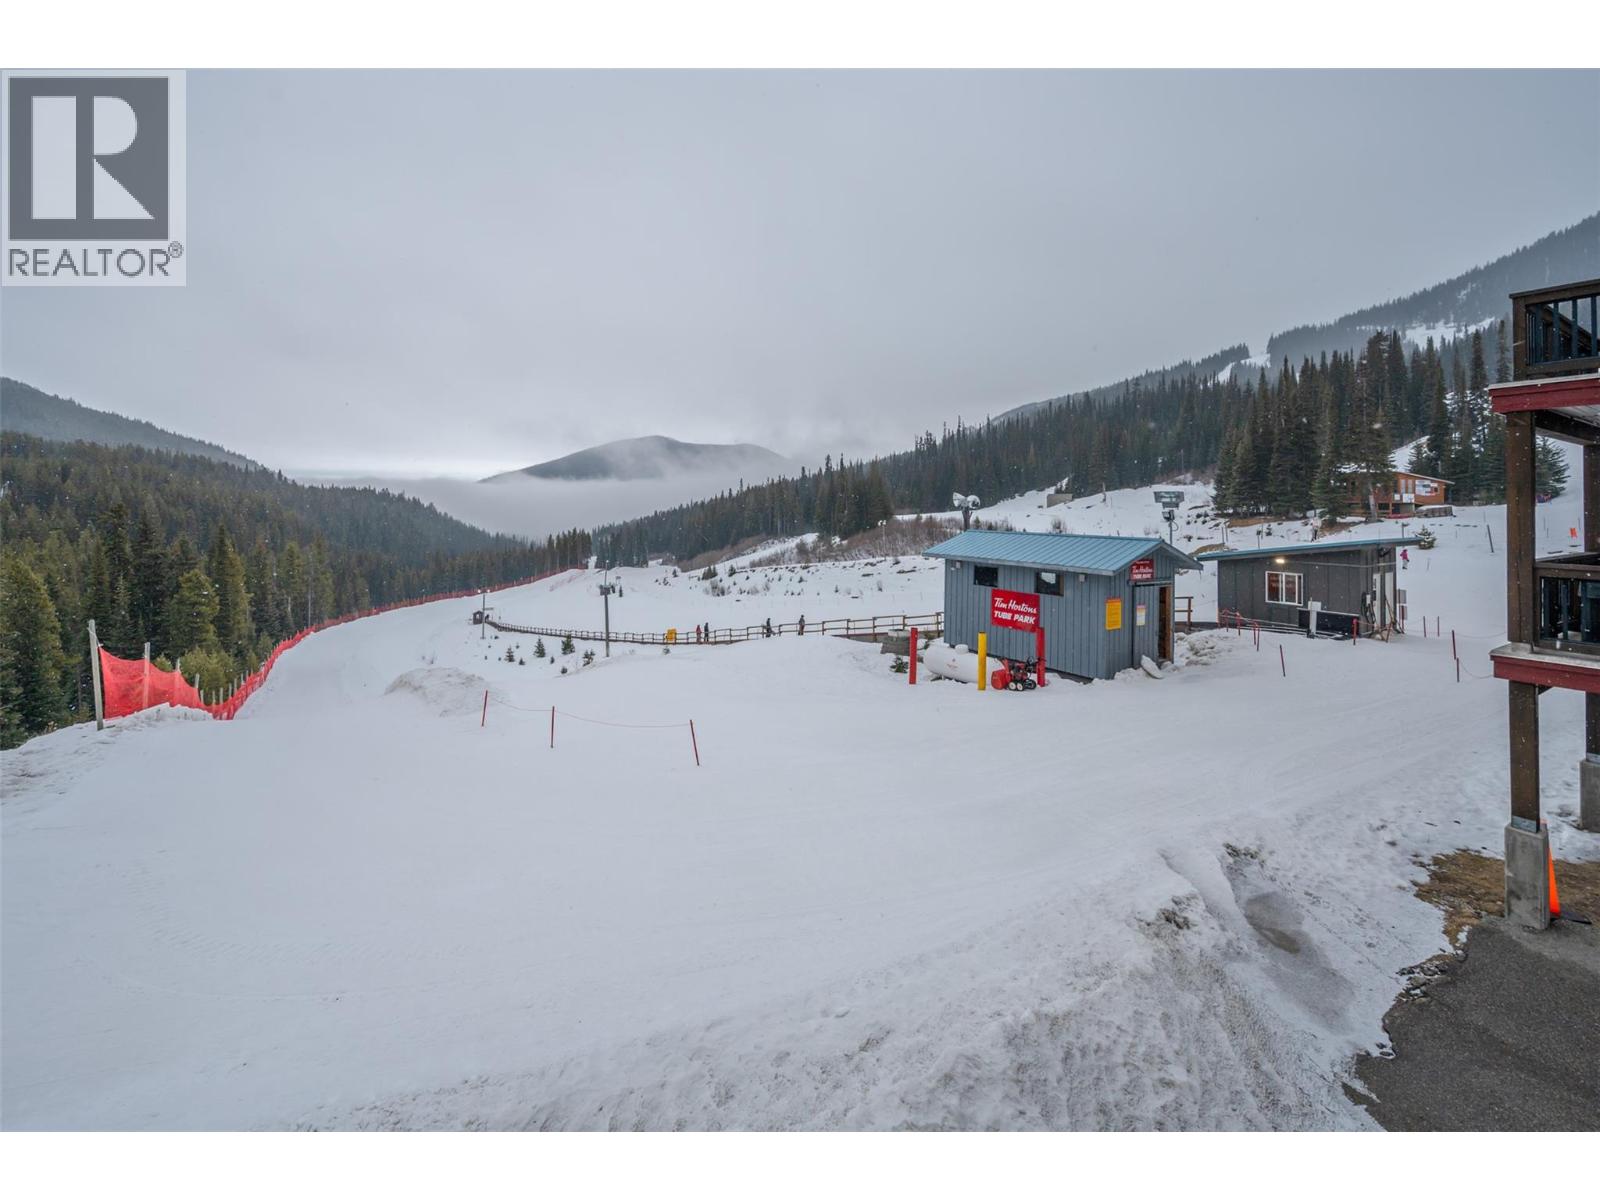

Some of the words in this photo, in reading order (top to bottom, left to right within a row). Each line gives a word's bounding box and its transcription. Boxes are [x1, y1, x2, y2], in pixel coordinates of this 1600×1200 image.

[994, 597, 1008, 609] Tim
[1008, 600, 1037, 614] Hortons
[994, 611, 1012, 620] TUBE
[1013, 614, 1035, 624] PARK
